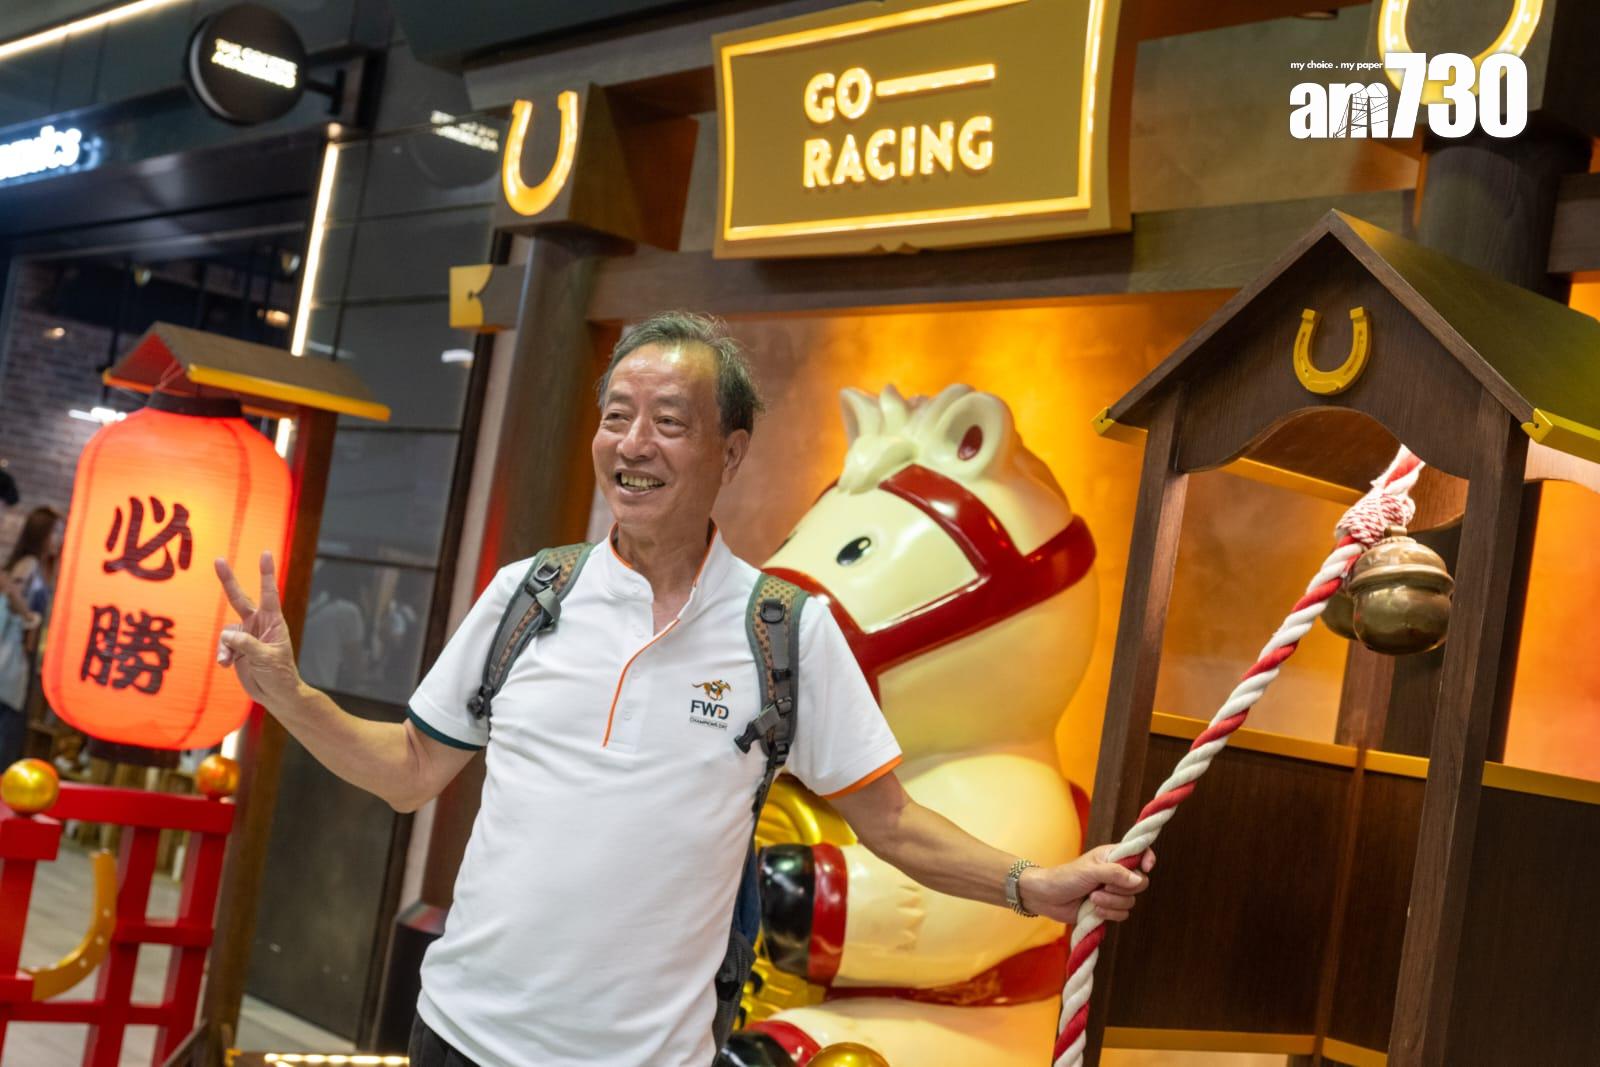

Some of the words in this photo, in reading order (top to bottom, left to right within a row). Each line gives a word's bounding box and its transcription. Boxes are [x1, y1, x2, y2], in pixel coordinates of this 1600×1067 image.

[803, 115, 993, 188] RACING
[81, 495, 193, 695] 必勝
[690, 699, 729, 720] FWD
